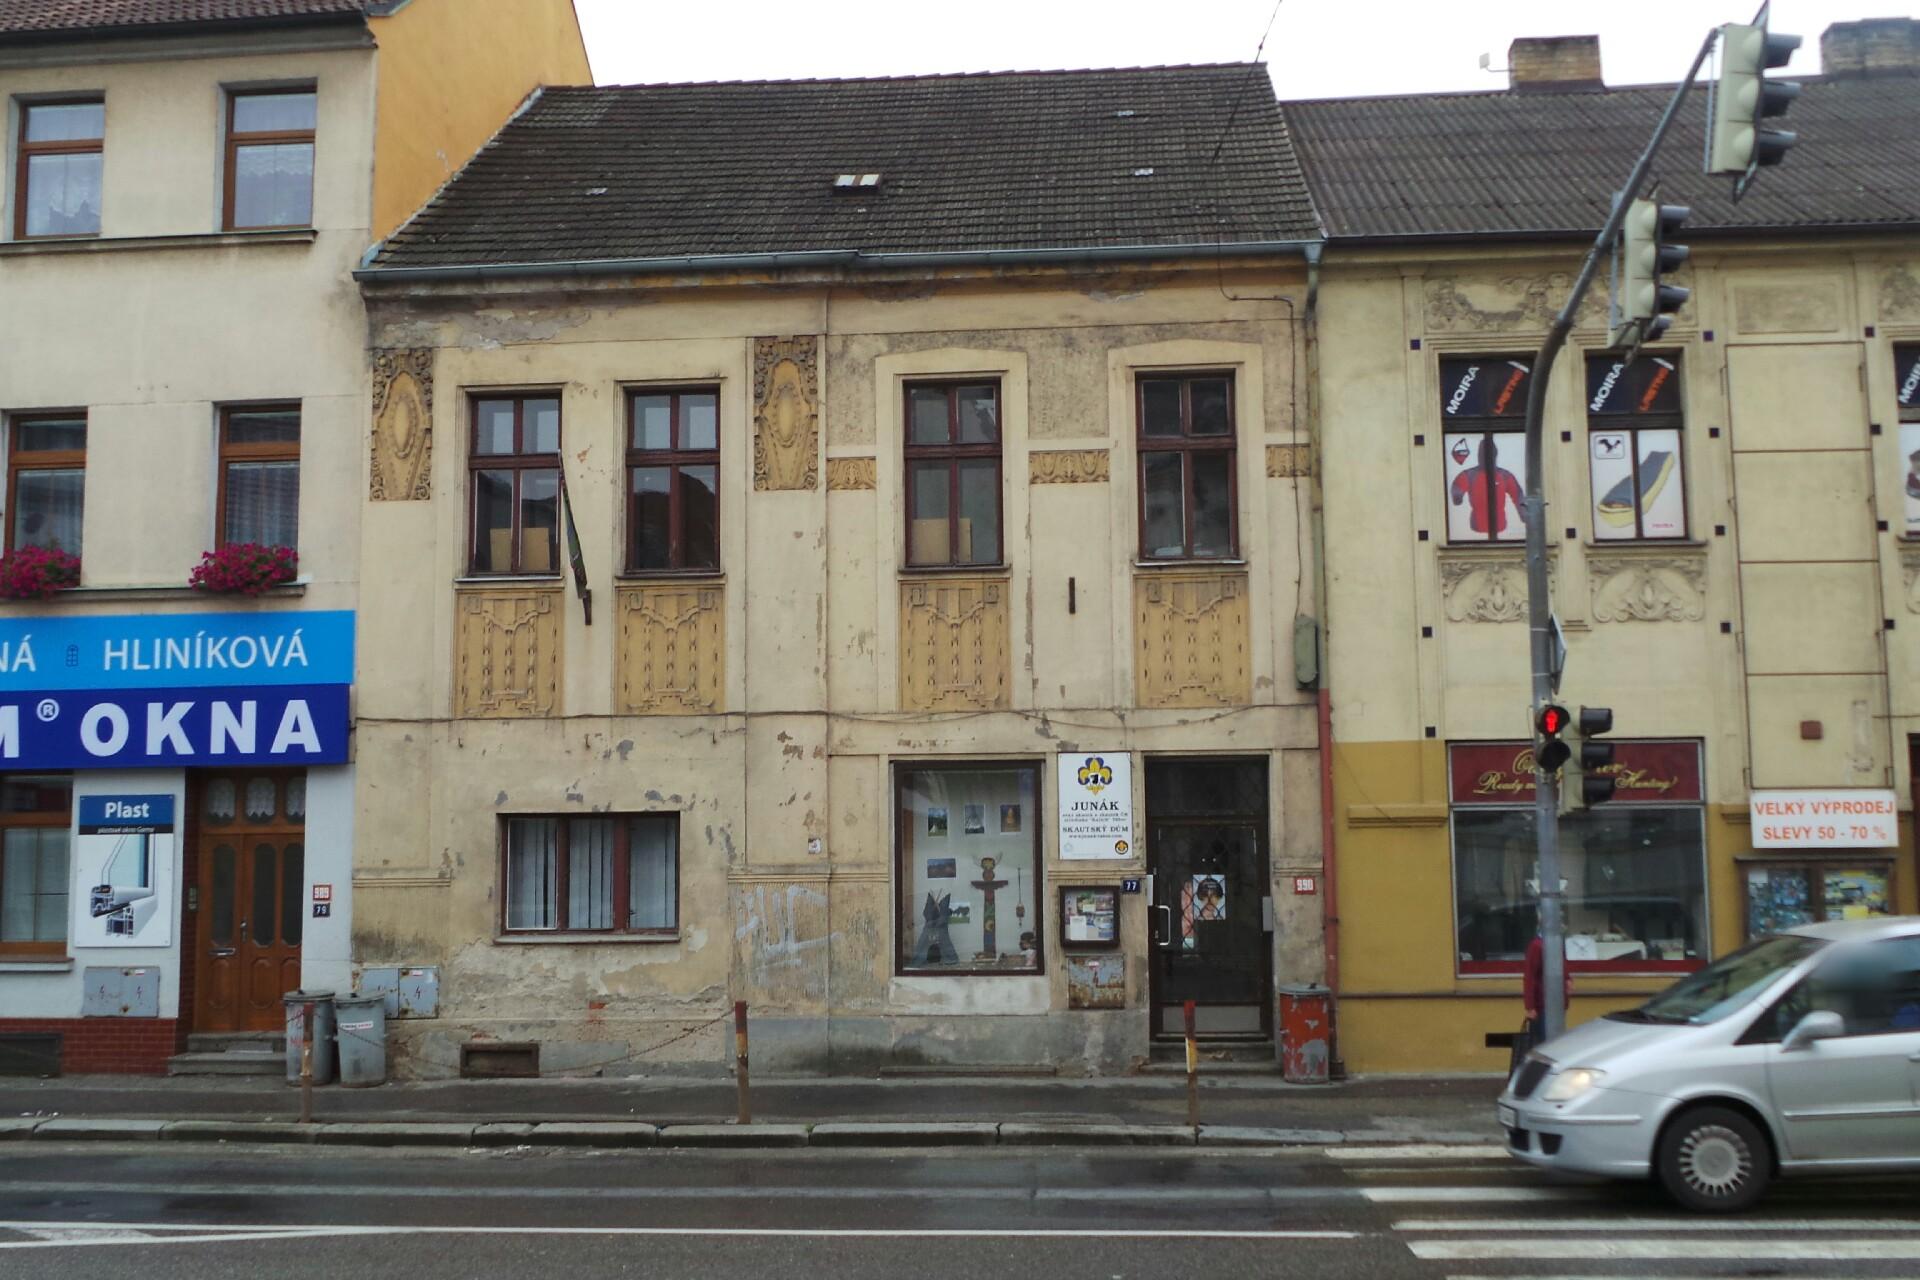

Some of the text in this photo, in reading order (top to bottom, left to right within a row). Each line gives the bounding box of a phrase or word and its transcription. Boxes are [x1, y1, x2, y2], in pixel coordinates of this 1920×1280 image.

[1446, 366, 1480, 414] MOIRA
[1590, 363, 1624, 411] MOIRA
[104, 629, 308, 671] HLINÍKOVÁ
[80, 700, 322, 757] OKNA
[104, 801, 150, 818] Plast
[1071, 798, 1120, 811] JUNÁK
[1754, 797, 1894, 815] VELKÝ VÝPRODEJ
[1062, 824, 1129, 833] SKAUTSKÝ DŮM
[1763, 826, 1812, 840] SLEVY
[1817, 826, 1836, 839] 50
[1851, 826, 1869, 839] 70
[1873, 825, 1888, 840] %
